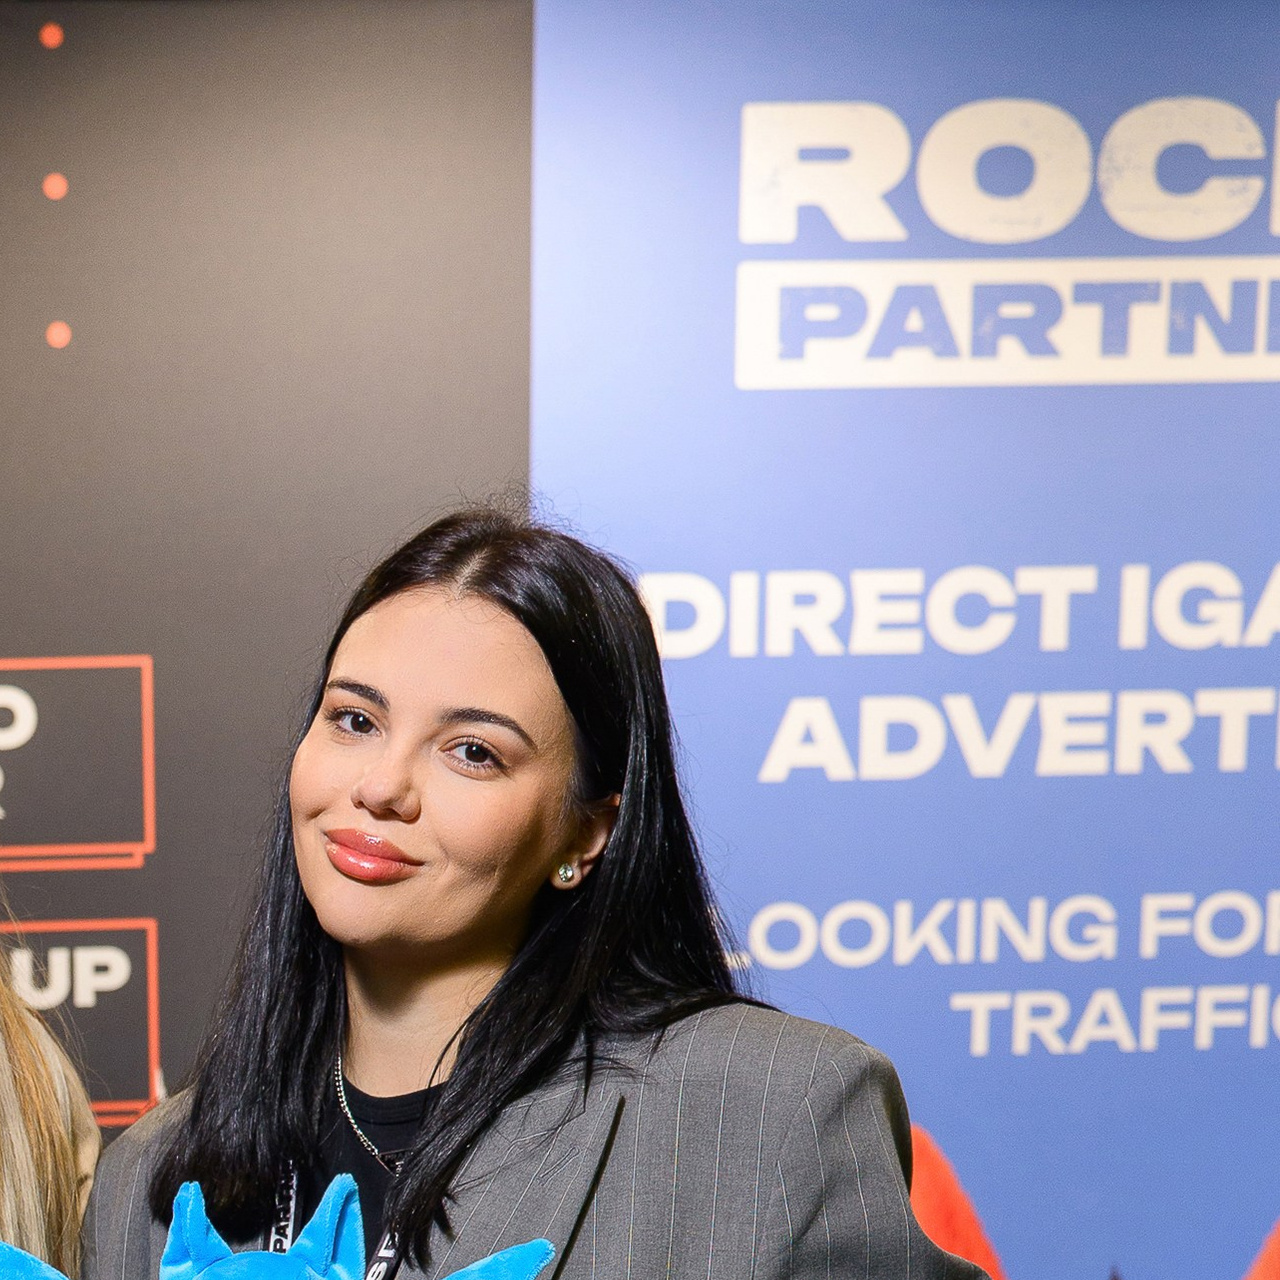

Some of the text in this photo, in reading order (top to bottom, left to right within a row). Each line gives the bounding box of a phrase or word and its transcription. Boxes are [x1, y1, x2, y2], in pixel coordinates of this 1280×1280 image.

[738, 96, 1280, 244] ROC
[778, 278, 1280, 360] PARTN
[640, 564, 1099, 660] DIRECT
[756, 687, 1280, 783] ADVERT
[949, 984, 1280, 1058] TRAFFI
